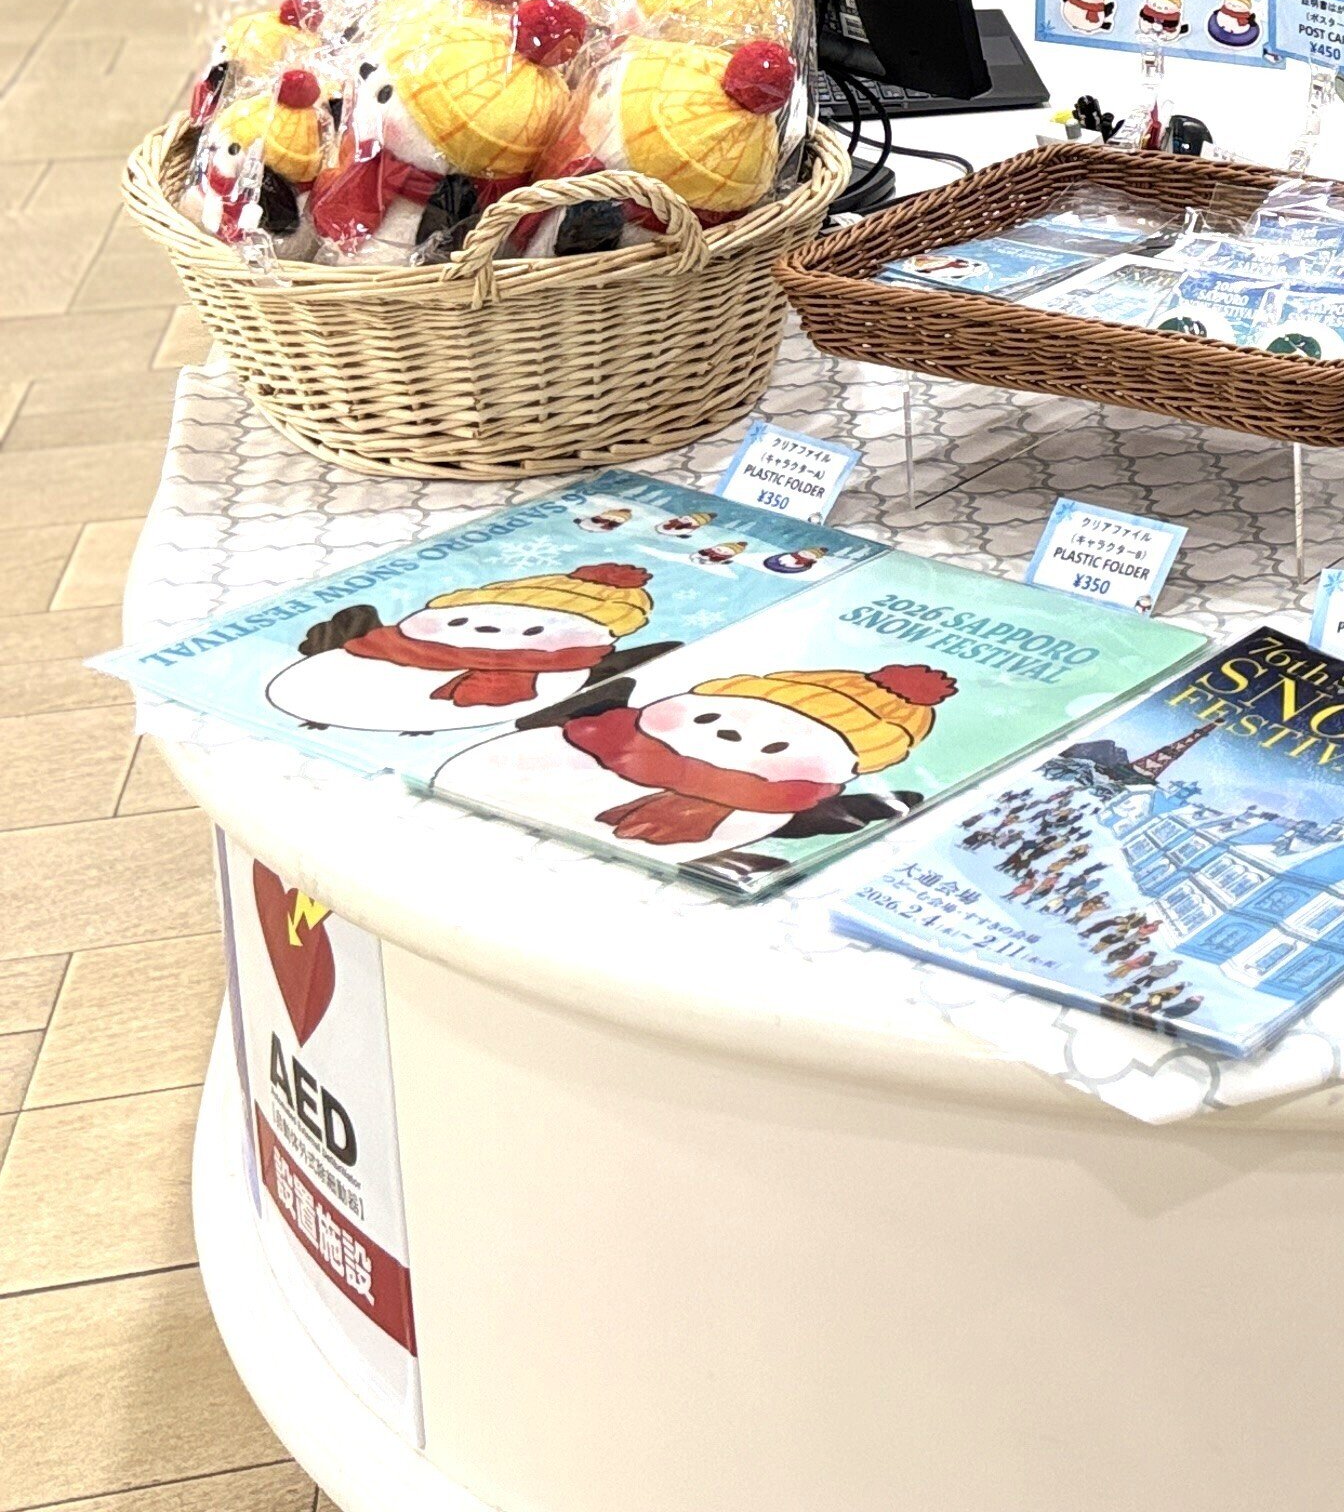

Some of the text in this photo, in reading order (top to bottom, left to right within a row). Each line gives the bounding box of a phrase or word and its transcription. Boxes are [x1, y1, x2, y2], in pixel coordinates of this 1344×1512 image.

[1297, 23, 1327, 41] POST
[1308, 40, 1342, 61] ¥450
[743, 463, 826, 499] PLASTIC FOLDER
[756, 489, 790, 510] ¥350
[1080, 516, 1153, 543] クリアファイル
[1052, 546, 1151, 582] PLASTIC FOLDER
[1071, 573, 1112, 596] ¥350
[137, 557, 420, 668] SNOW FESTIVAL
[871, 593, 1101, 666] 2026 SAPPORO
[837, 605, 1072, 685] SNOW FESTIVAL
[1246, 636, 1327, 688] 76th
[270, 1030, 358, 1168] AED
[273, 1145, 376, 1307] 設置施設
